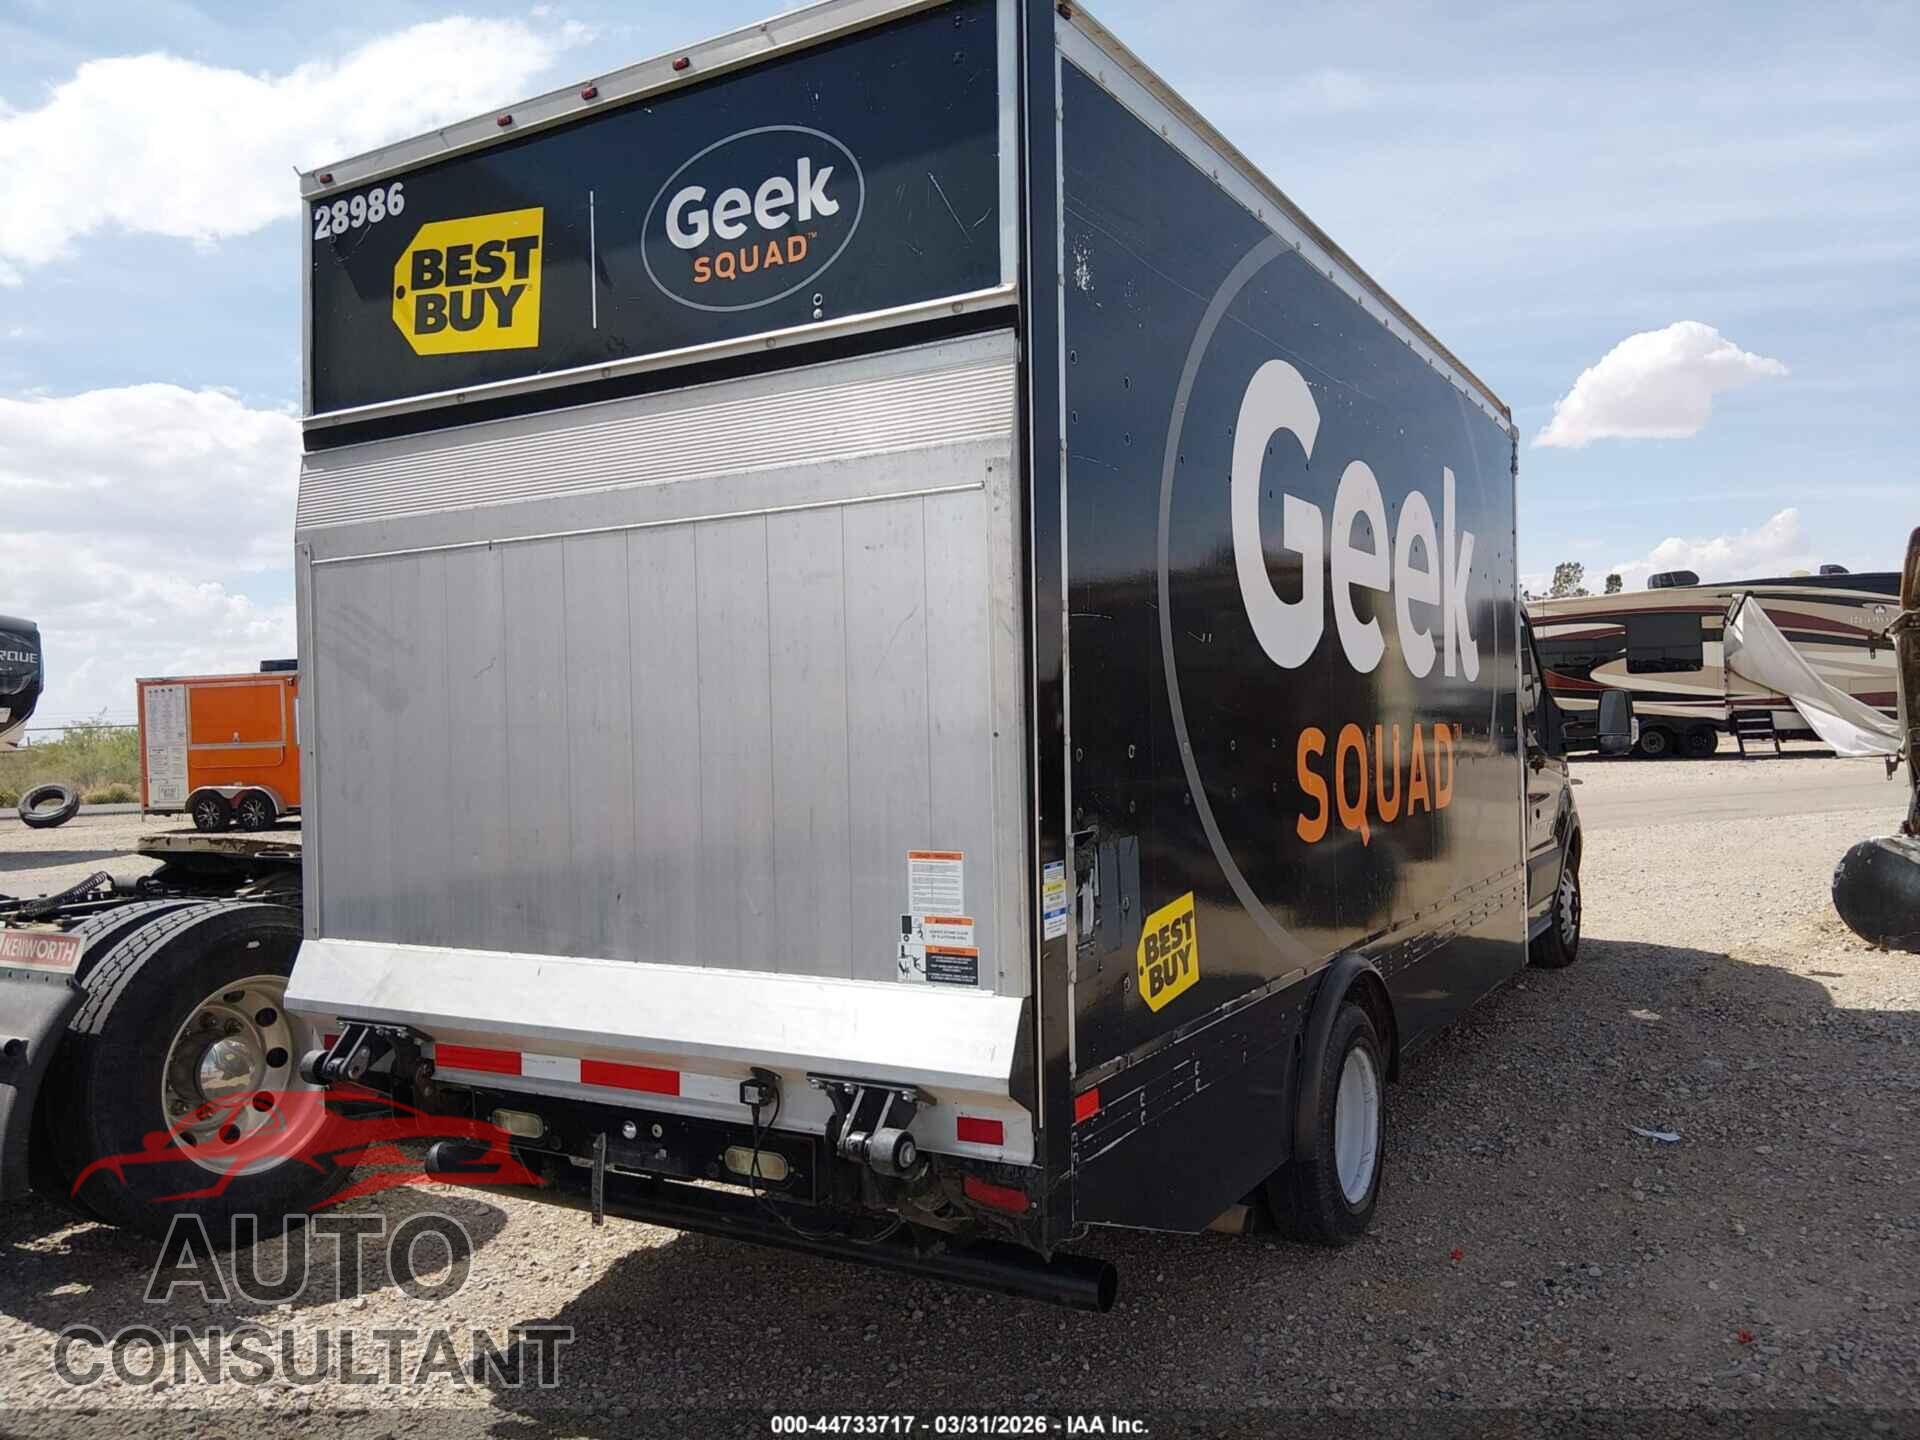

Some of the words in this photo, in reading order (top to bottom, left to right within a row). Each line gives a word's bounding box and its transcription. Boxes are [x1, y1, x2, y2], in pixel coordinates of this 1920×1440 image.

[314, 182, 405, 240] 28986
[665, 157, 840, 249] Geek
[411, 235, 539, 291] BEST
[694, 235, 807, 283] SQUAD
[414, 284, 527, 335] BUY
[1231, 359, 1480, 682] Geek
[1297, 722, 1454, 847] SQUAD
[2, 937, 77, 961] KENWORTH
[1144, 910, 1193, 967] BEST
[1150, 943, 1191, 998] BUY
